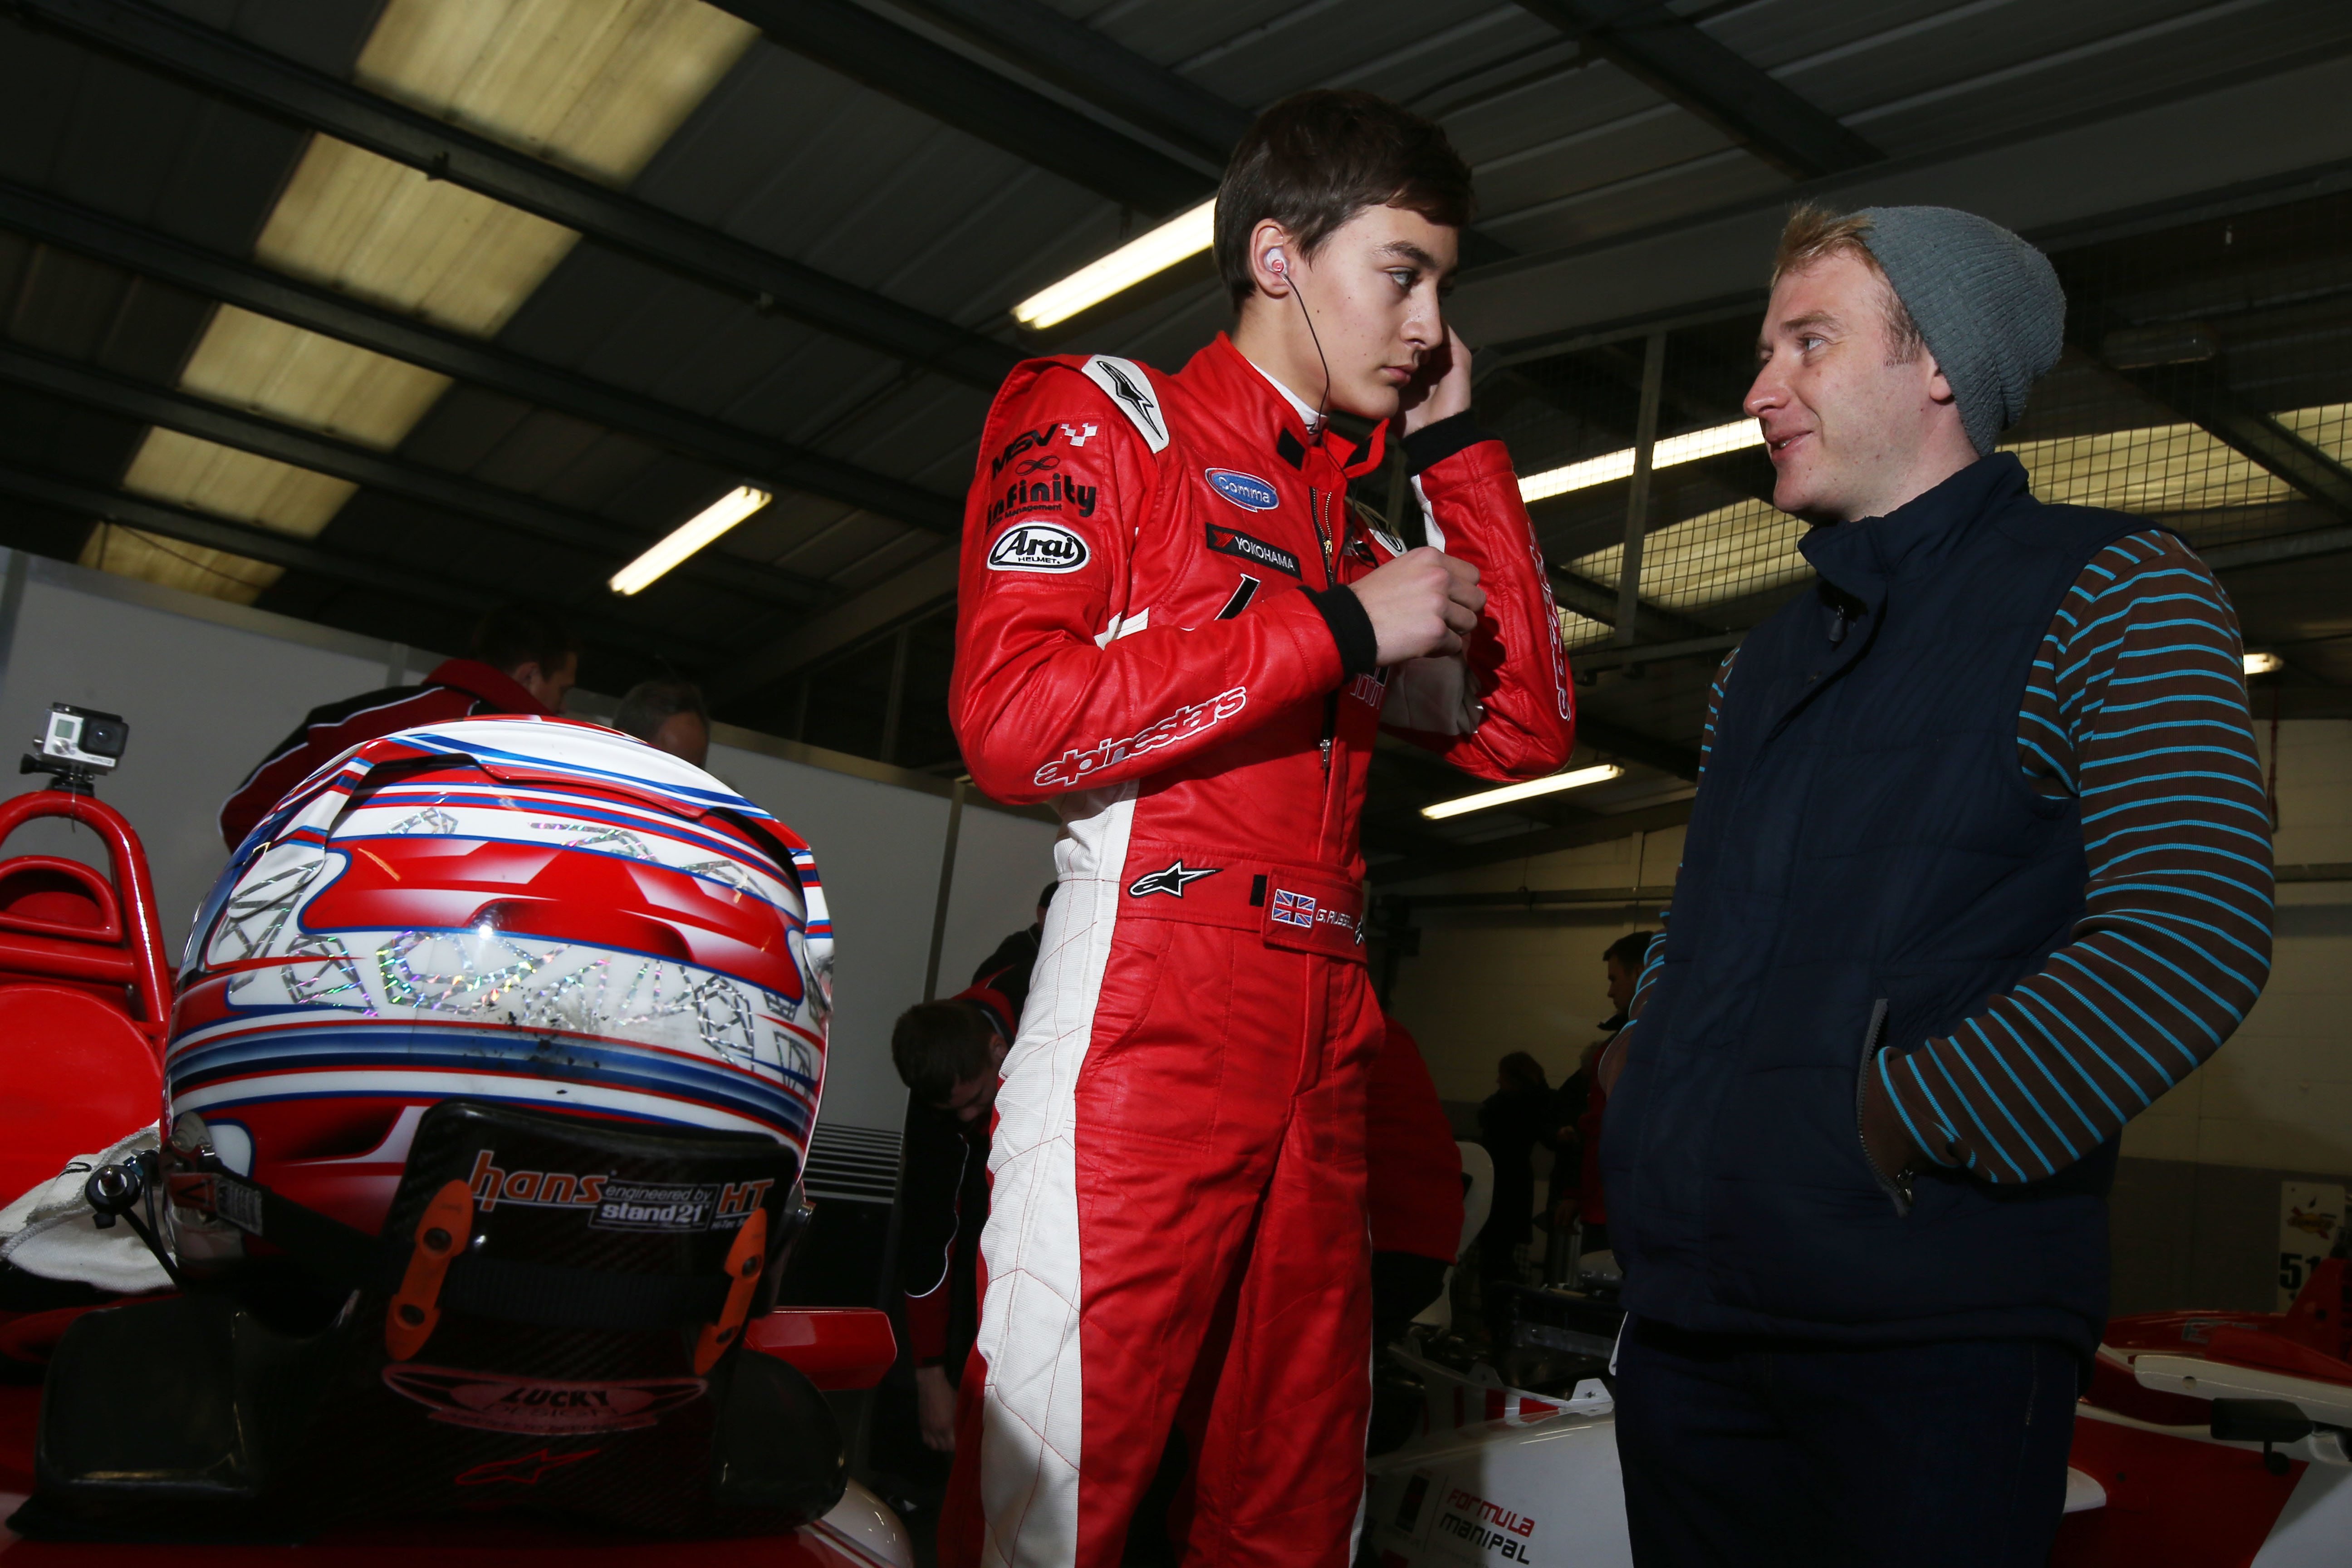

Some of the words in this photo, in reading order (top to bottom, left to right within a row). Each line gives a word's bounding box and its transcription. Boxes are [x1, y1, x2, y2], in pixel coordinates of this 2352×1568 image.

[1219, 477, 1270, 504] Comma
[995, 530, 1075, 562] Arai
[1235, 536, 1295, 571] YOKOHAMA
[1033, 686, 1247, 787] alpinestars
[470, 1150, 608, 1212] hans
[605, 1185, 693, 1201] engineered
[694, 1187, 714, 1202] by
[717, 1178, 775, 1215] HT
[501, 1387, 610, 1406] LUCKY
